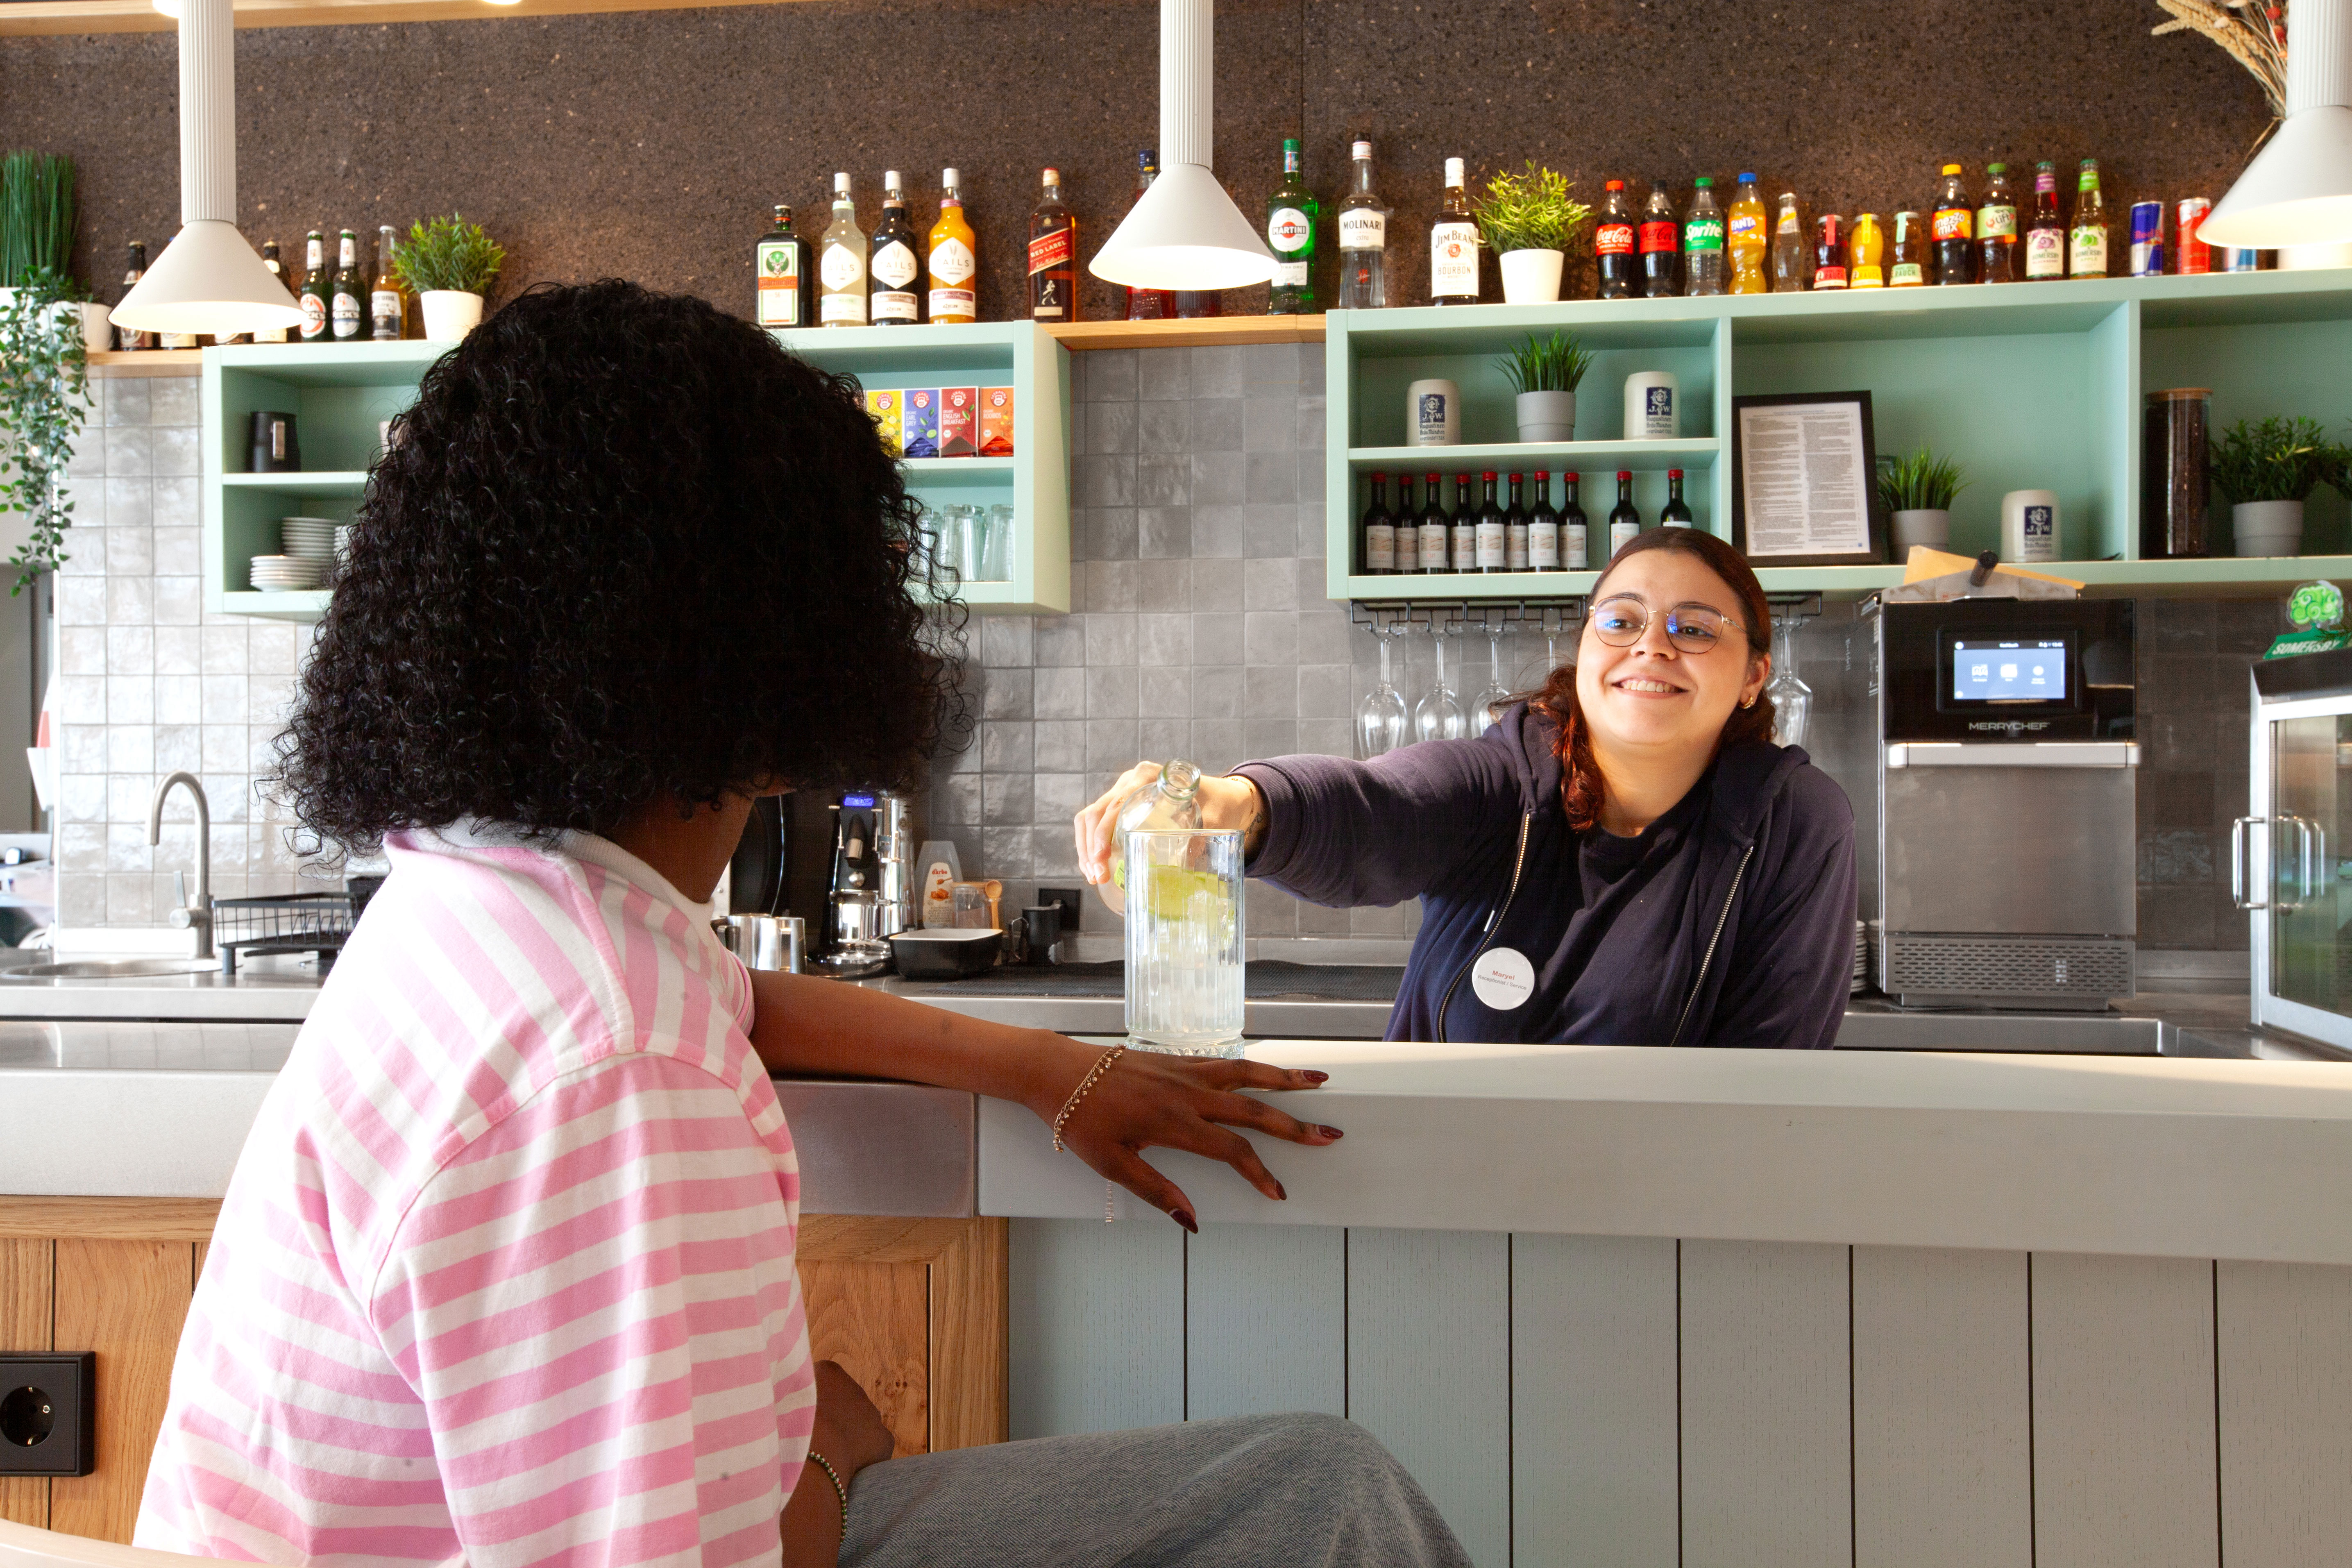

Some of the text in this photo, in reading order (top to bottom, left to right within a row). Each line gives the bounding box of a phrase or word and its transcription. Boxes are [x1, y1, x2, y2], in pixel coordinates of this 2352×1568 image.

[1344, 220, 1381, 230] MOLINARI
[1935, 212, 1965, 229] mezzo
[1685, 222, 1721, 241] Sprite
[1938, 222, 1957, 236] mix
[1030, 241, 1066, 258] RED LABEL
[880, 262, 912, 270] AILS
[1438, 266, 1471, 275] BOURBON
[1478, 974, 1506, 985] Receptionist
[1510, 982, 1527, 990] Service
[1492, 970, 1515, 980] Maryel
